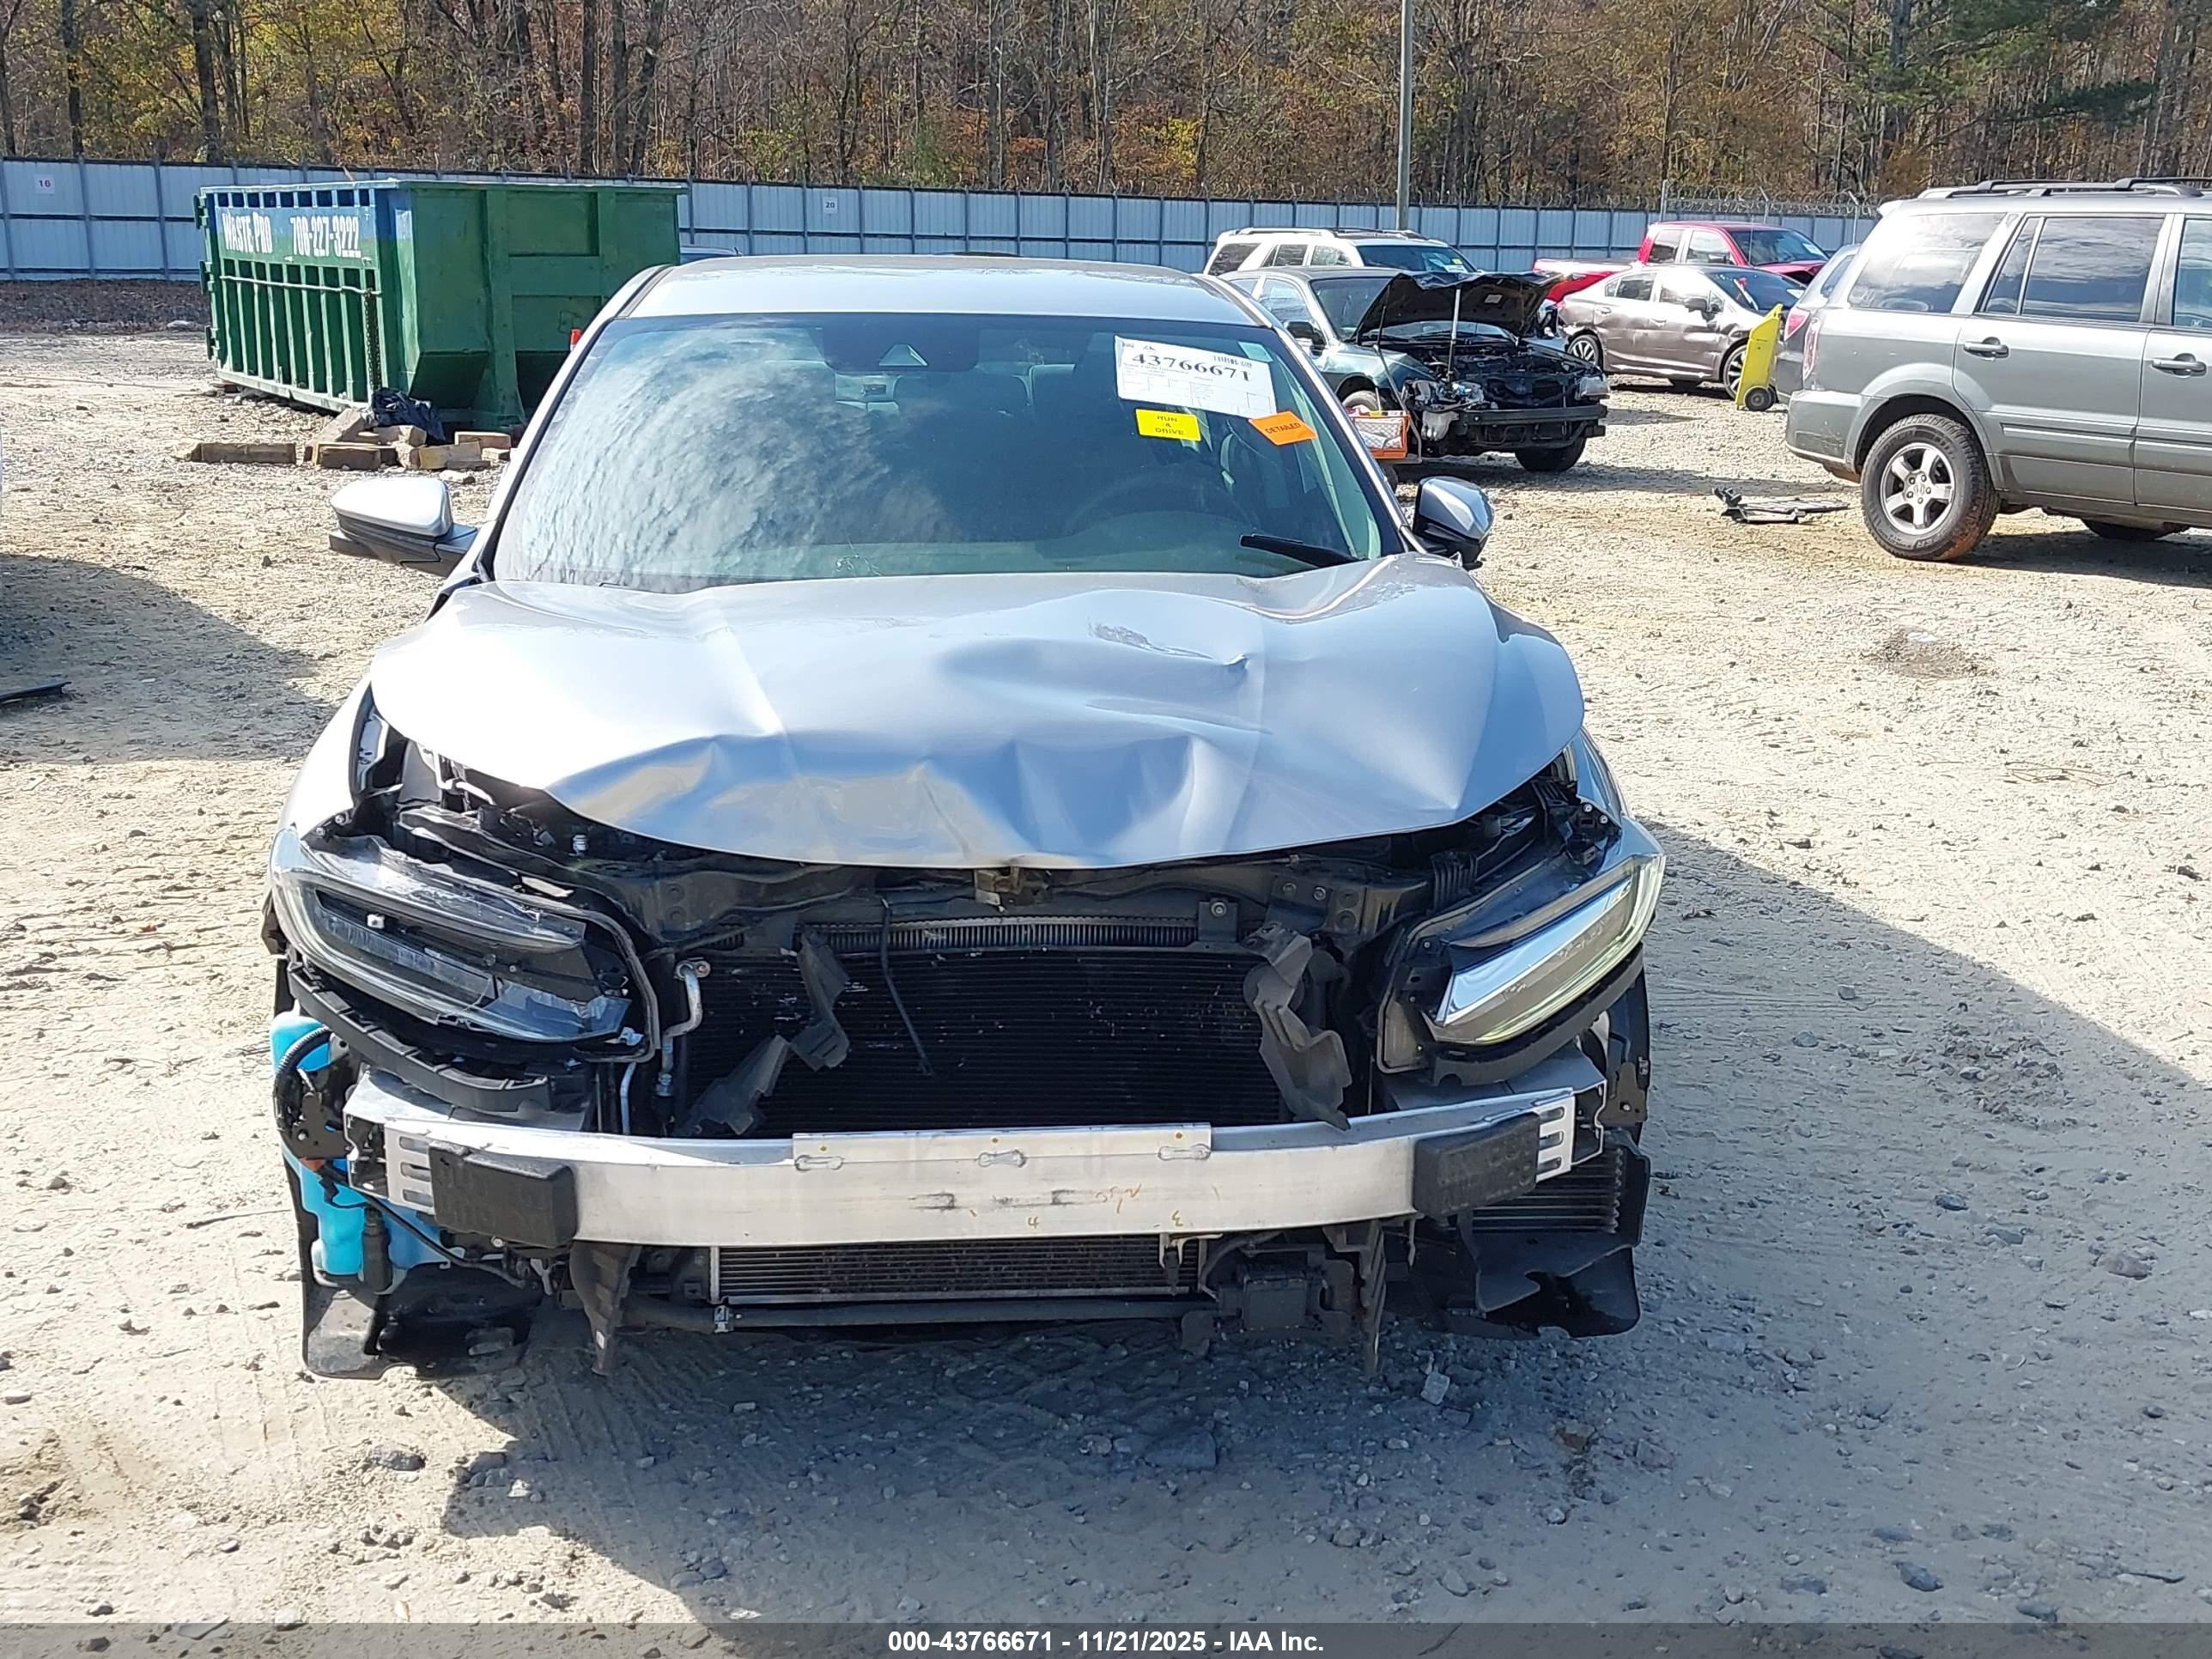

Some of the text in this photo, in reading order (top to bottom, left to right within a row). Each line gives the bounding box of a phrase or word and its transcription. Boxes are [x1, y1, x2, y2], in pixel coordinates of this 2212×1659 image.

[252, 211, 273, 254] PRO
[1132, 353, 1250, 382] 43766671
[1264, 422, 1302, 434] DETAILED
